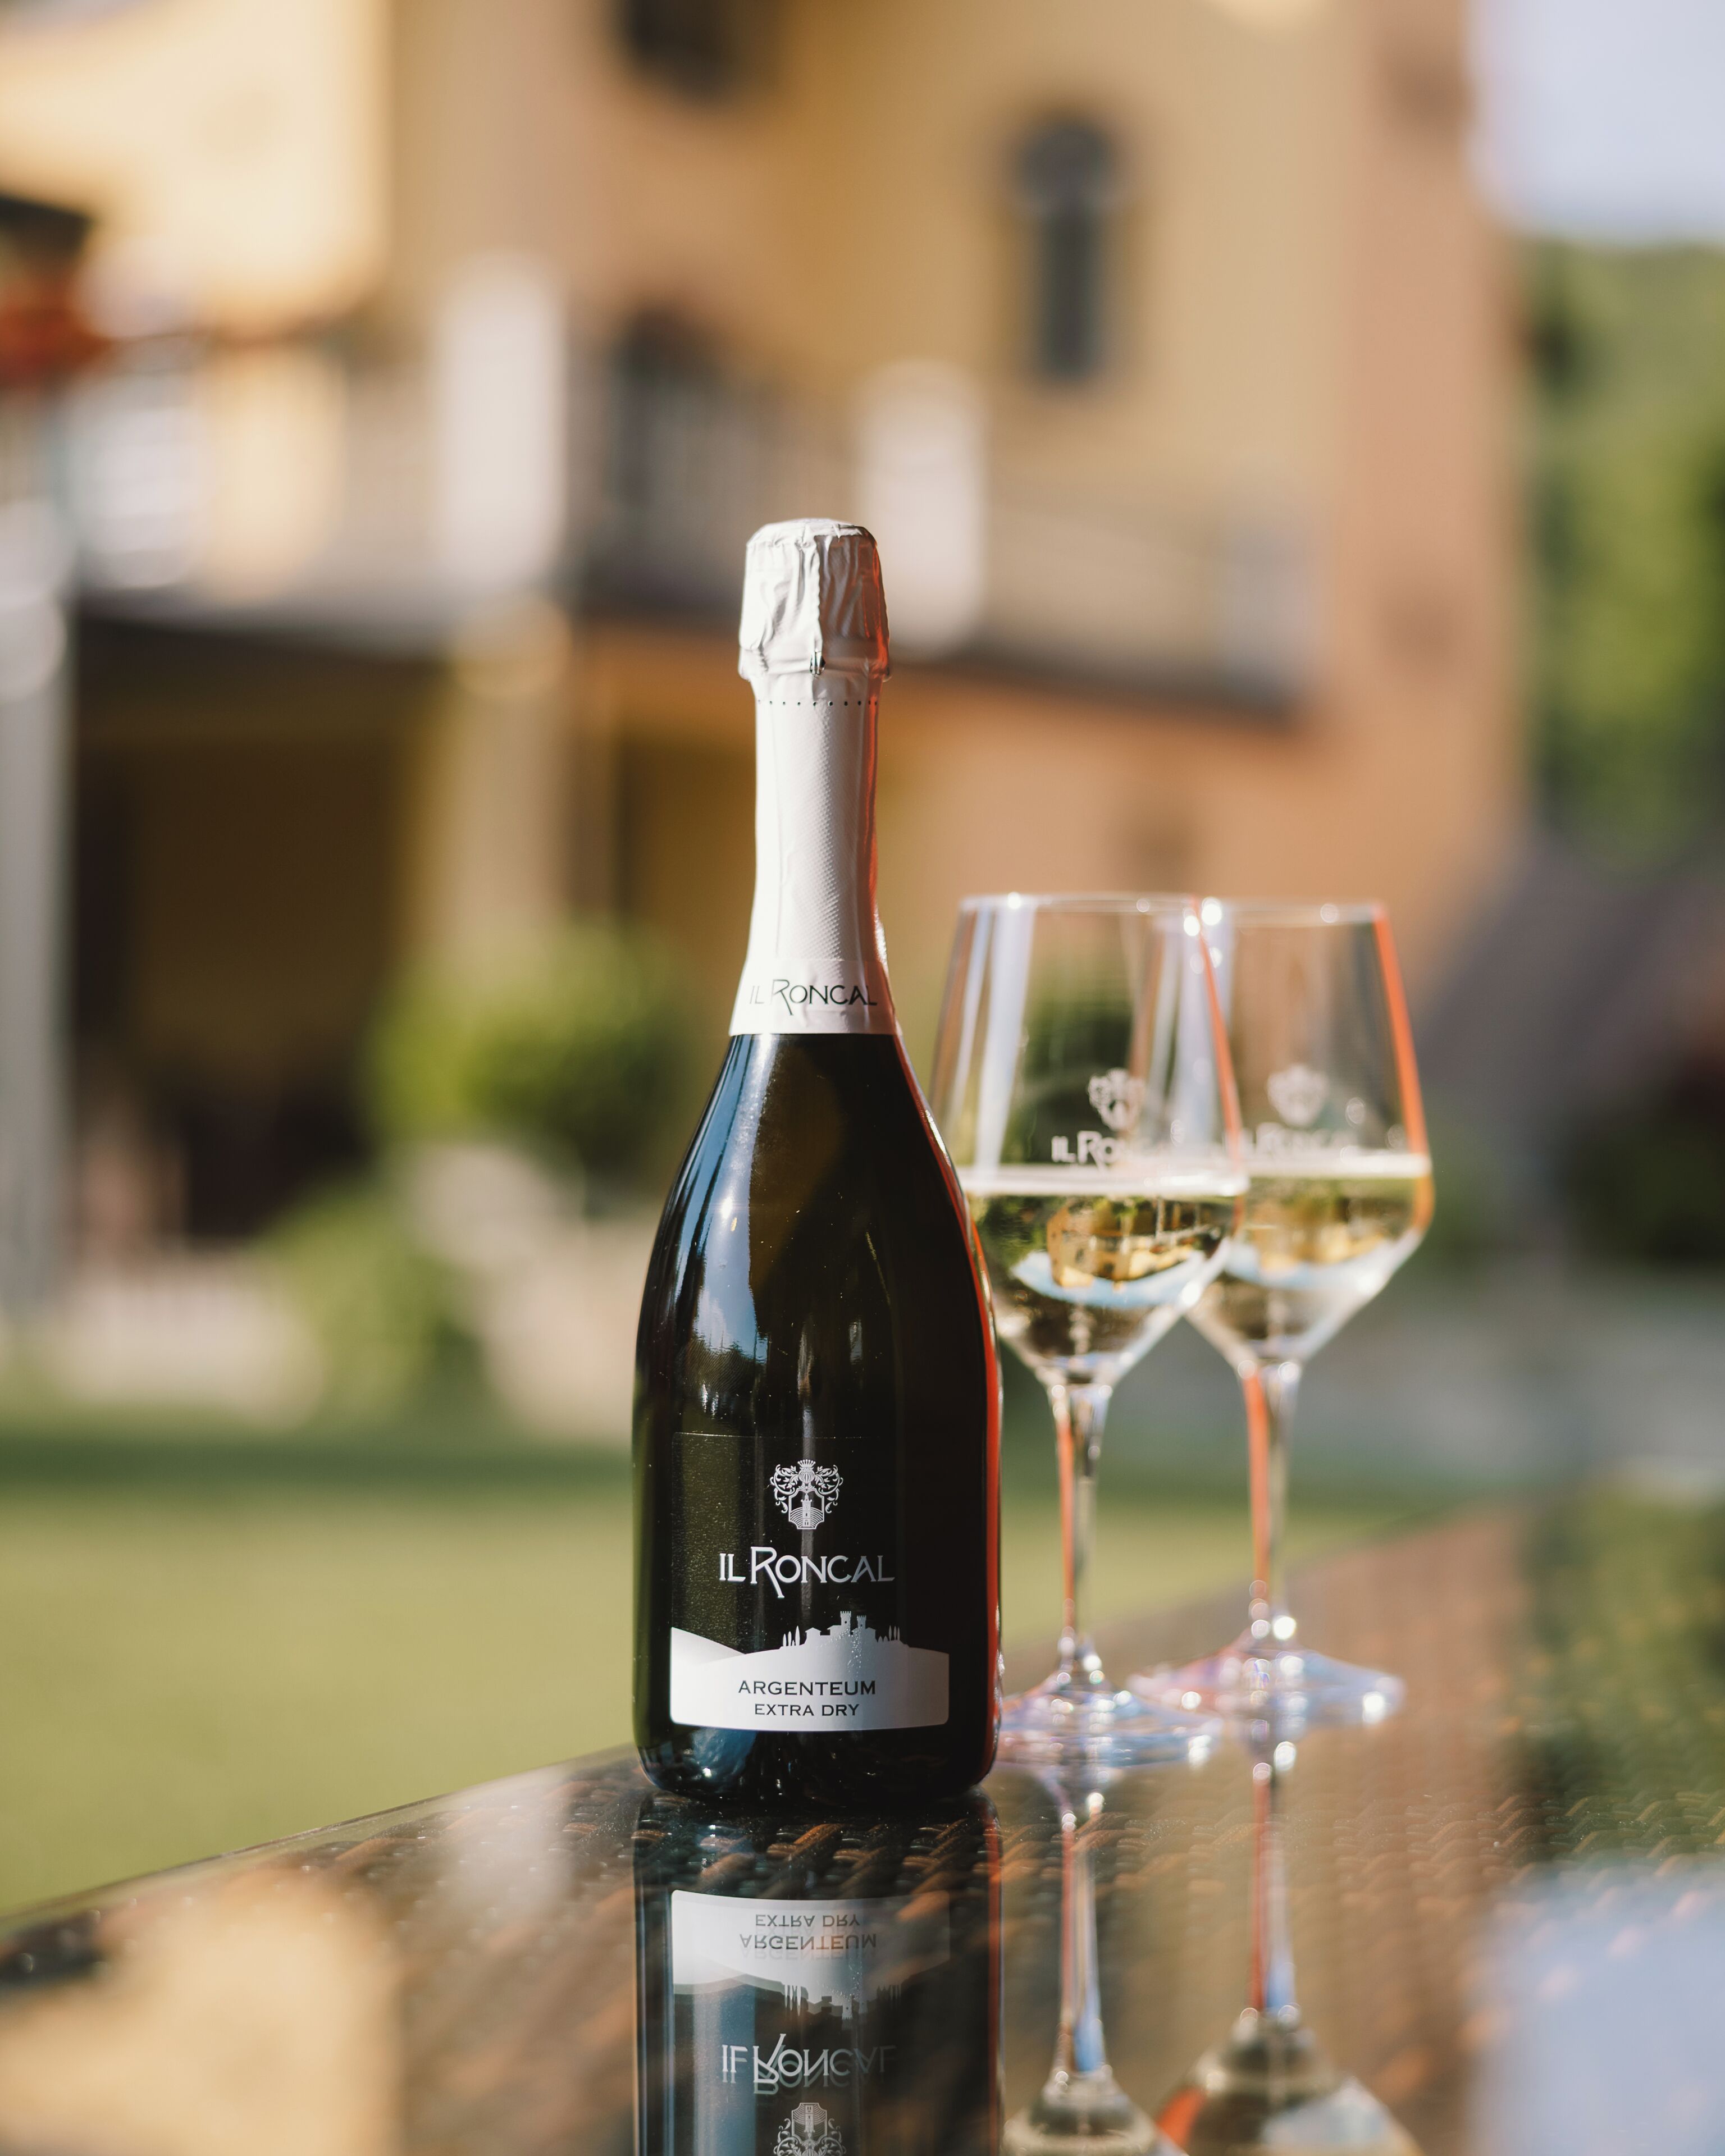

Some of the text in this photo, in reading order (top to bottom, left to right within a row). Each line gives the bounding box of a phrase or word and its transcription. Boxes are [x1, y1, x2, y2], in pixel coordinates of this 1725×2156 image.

[749, 979, 878, 1016] IL RONCAL
[719, 1546, 896, 1598] IL RONCAL
[738, 1680, 877, 1696] ARGENTEUM
[754, 1703, 860, 1716] EXTRA DRY
